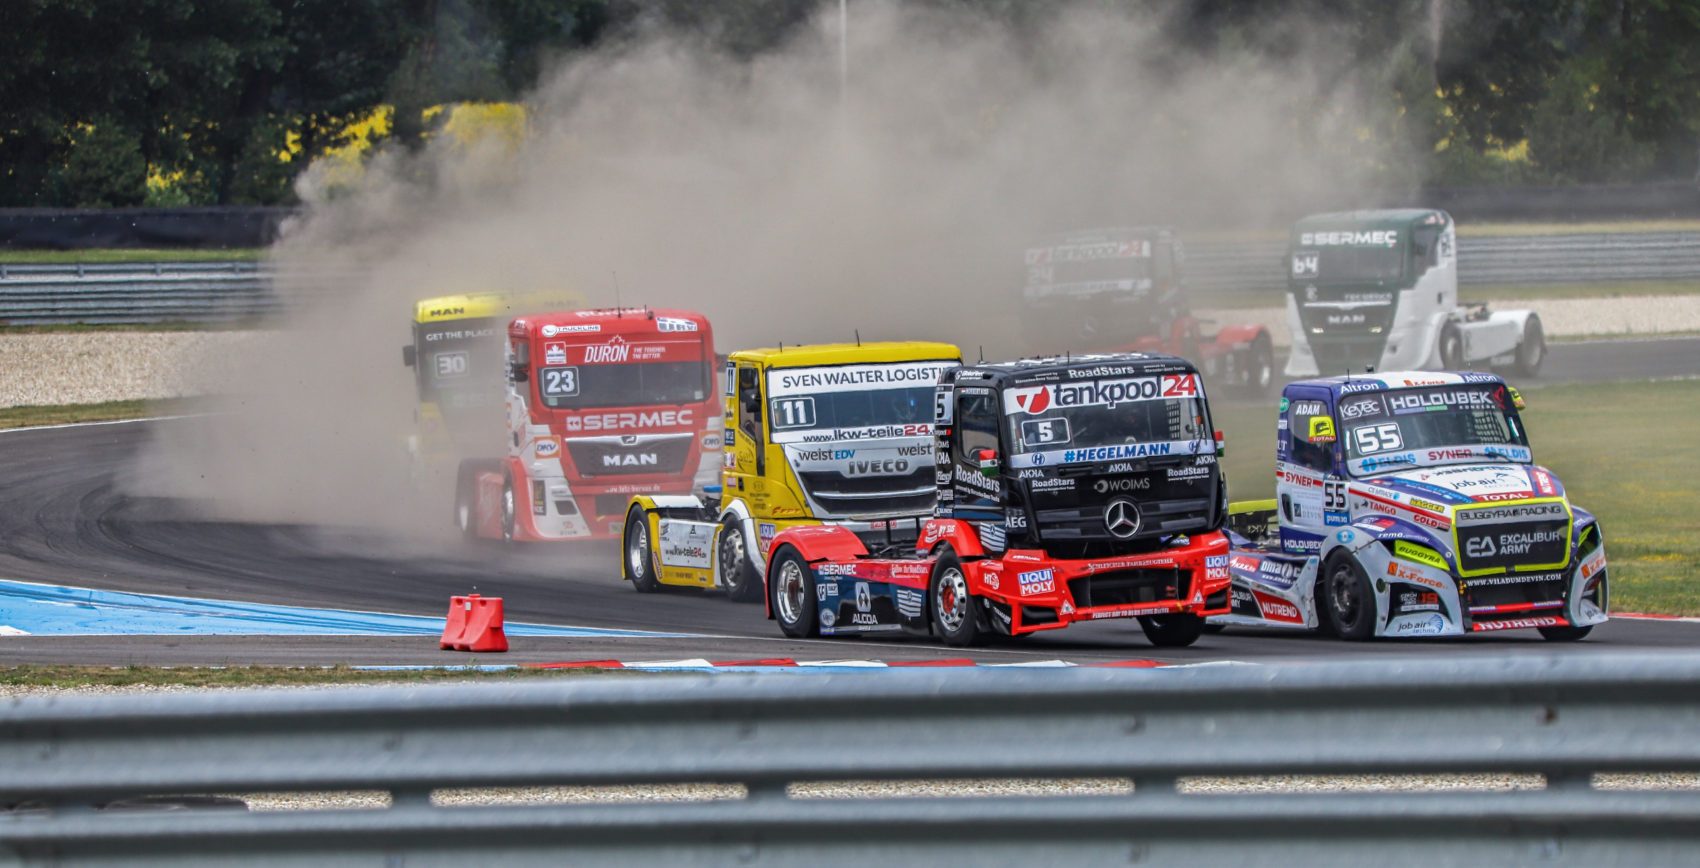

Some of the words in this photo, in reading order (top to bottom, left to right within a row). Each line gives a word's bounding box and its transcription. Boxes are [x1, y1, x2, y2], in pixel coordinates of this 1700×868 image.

[1314, 230, 1397, 246] SERMEC
[430, 307, 465, 317] MAN
[1328, 314, 1366, 325] MAN
[426, 332, 444, 341] GET
[445, 331, 463, 340] THE
[584, 344, 630, 363] DURON
[438, 355, 466, 375] 30
[1068, 366, 1135, 379] RoadStars
[545, 370, 576, 394] 23
[782, 373, 822, 389] SVEN
[823, 370, 884, 386] WALTER
[1465, 375, 1497, 383] Altron
[1053, 373, 1198, 410] tankpool24
[1341, 382, 1380, 394] Altron
[1390, 391, 1494, 409] HOLOUBEK
[782, 400, 808, 425] 11
[1296, 404, 1321, 415] ADAM
[583, 409, 694, 431] SERMEC
[803, 424, 936, 443] www.lkw-teile24.
[1037, 421, 1054, 443] 5
[1356, 424, 1401, 453] 55
[798, 449, 834, 462] weist
[835, 450, 856, 461] EDV
[897, 443, 933, 458] weist
[1064, 442, 1171, 463] #HEGELMANN
[1428, 449, 1473, 461] SYNER
[603, 453, 658, 467] MAN
[848, 458, 910, 475] IVECO
[955, 464, 1001, 493] RoadStars
[1167, 466, 1210, 477] RoadStars
[1031, 478, 1075, 489] RoadStars
[1285, 471, 1313, 488] SYNER
[1450, 480, 1477, 490] job
[1324, 482, 1346, 508] 55
[1479, 493, 1530, 501] TOTAL
[1369, 501, 1397, 516] TANGO
[1460, 509, 1513, 521] BUGGYRA
[1516, 505, 1562, 516] RACING
[1005, 516, 1027, 528] AEG
[1413, 514, 1438, 528] GOLD
[1500, 531, 1561, 544] EXCALIBUR
[1399, 546, 1441, 564] BUGGYRA
[1500, 544, 1531, 555] ARMY
[824, 564, 857, 576] SERMEC
[1019, 569, 1053, 585] LIQUI
[1467, 573, 1563, 587] WWW.VILADUMDEVIN.COM
[1020, 580, 1055, 596] MOLY
[1262, 601, 1298, 618] NUTREND
[852, 613, 879, 625] ALCOA
[1477, 616, 1558, 631] NUTREND
[1397, 622, 1413, 633] job
[1414, 621, 1427, 629] air
